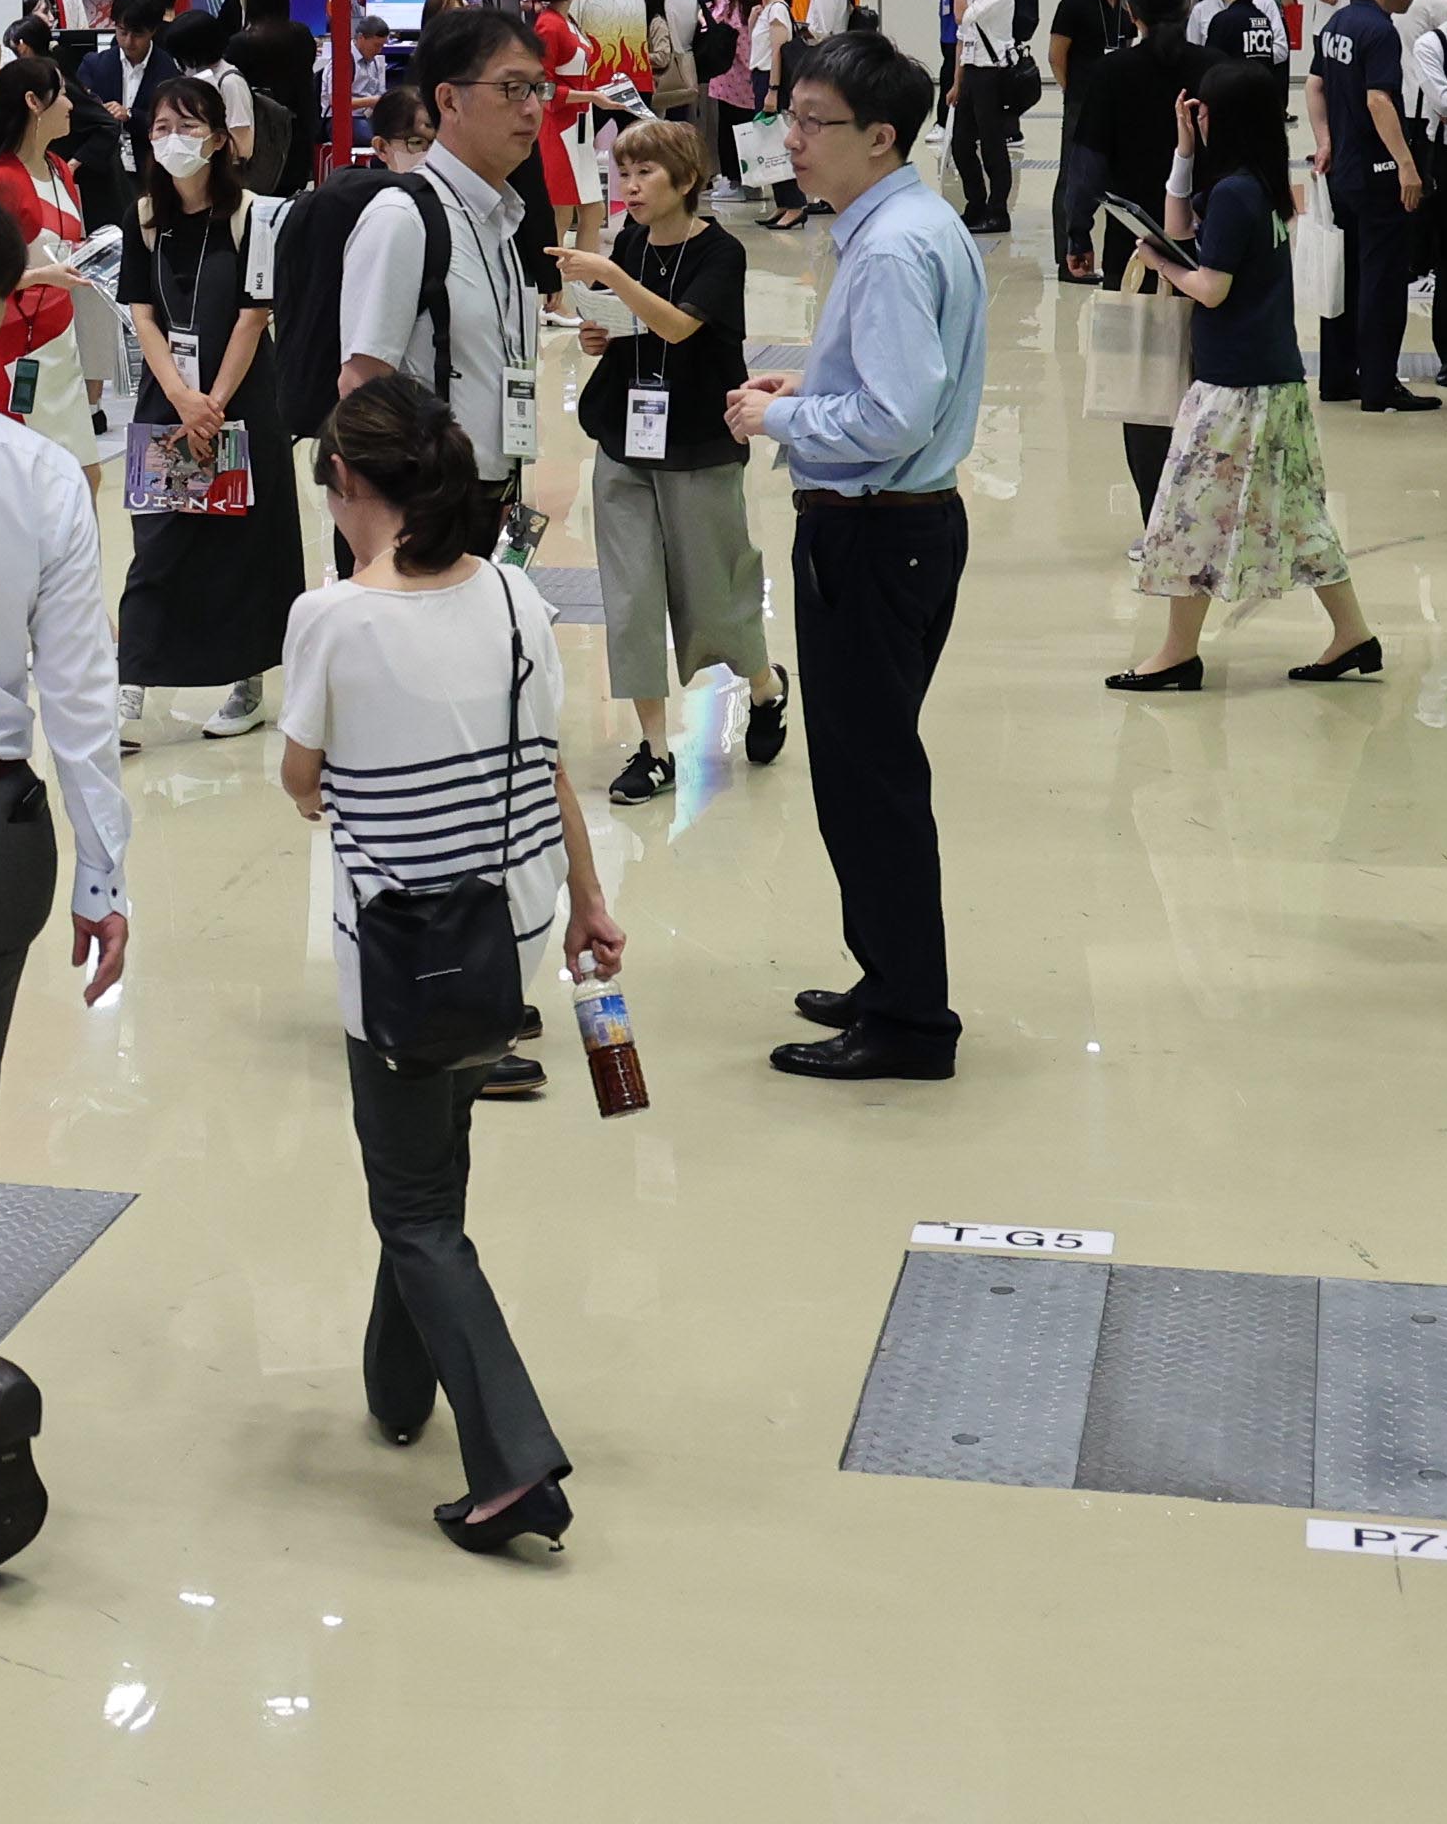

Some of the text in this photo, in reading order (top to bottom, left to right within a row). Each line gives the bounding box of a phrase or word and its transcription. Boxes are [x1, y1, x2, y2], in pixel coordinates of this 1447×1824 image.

[1321, 31, 1354, 64] NGB
[1373, 160, 1397, 173] NGB
[944, 1226, 1084, 1249] T-G5
